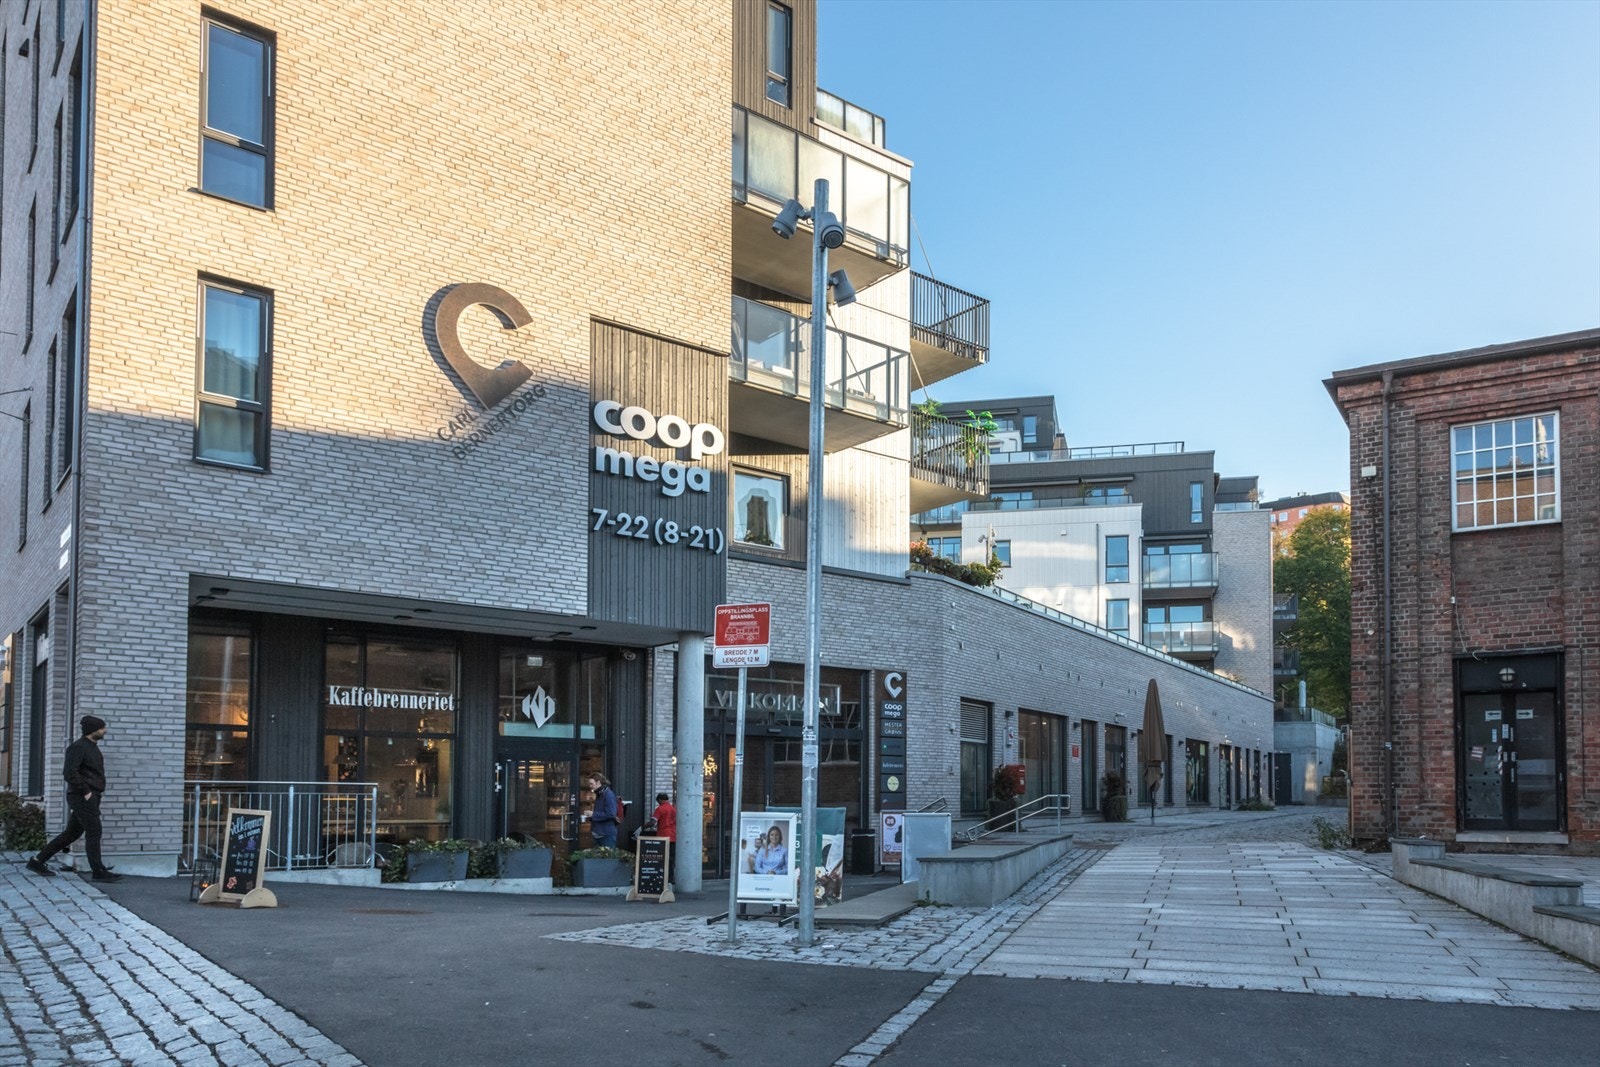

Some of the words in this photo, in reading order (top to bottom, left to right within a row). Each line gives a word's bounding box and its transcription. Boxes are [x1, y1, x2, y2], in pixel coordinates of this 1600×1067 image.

[437, 409, 478, 441] CARL
[593, 400, 725, 461] coop
[595, 446, 711, 497] mega
[592, 508, 649, 539] 7-22
[654, 517, 724, 555] (8-21)
[329, 685, 455, 711] Kaffebrenneriet
[884, 703, 902, 711] coop
